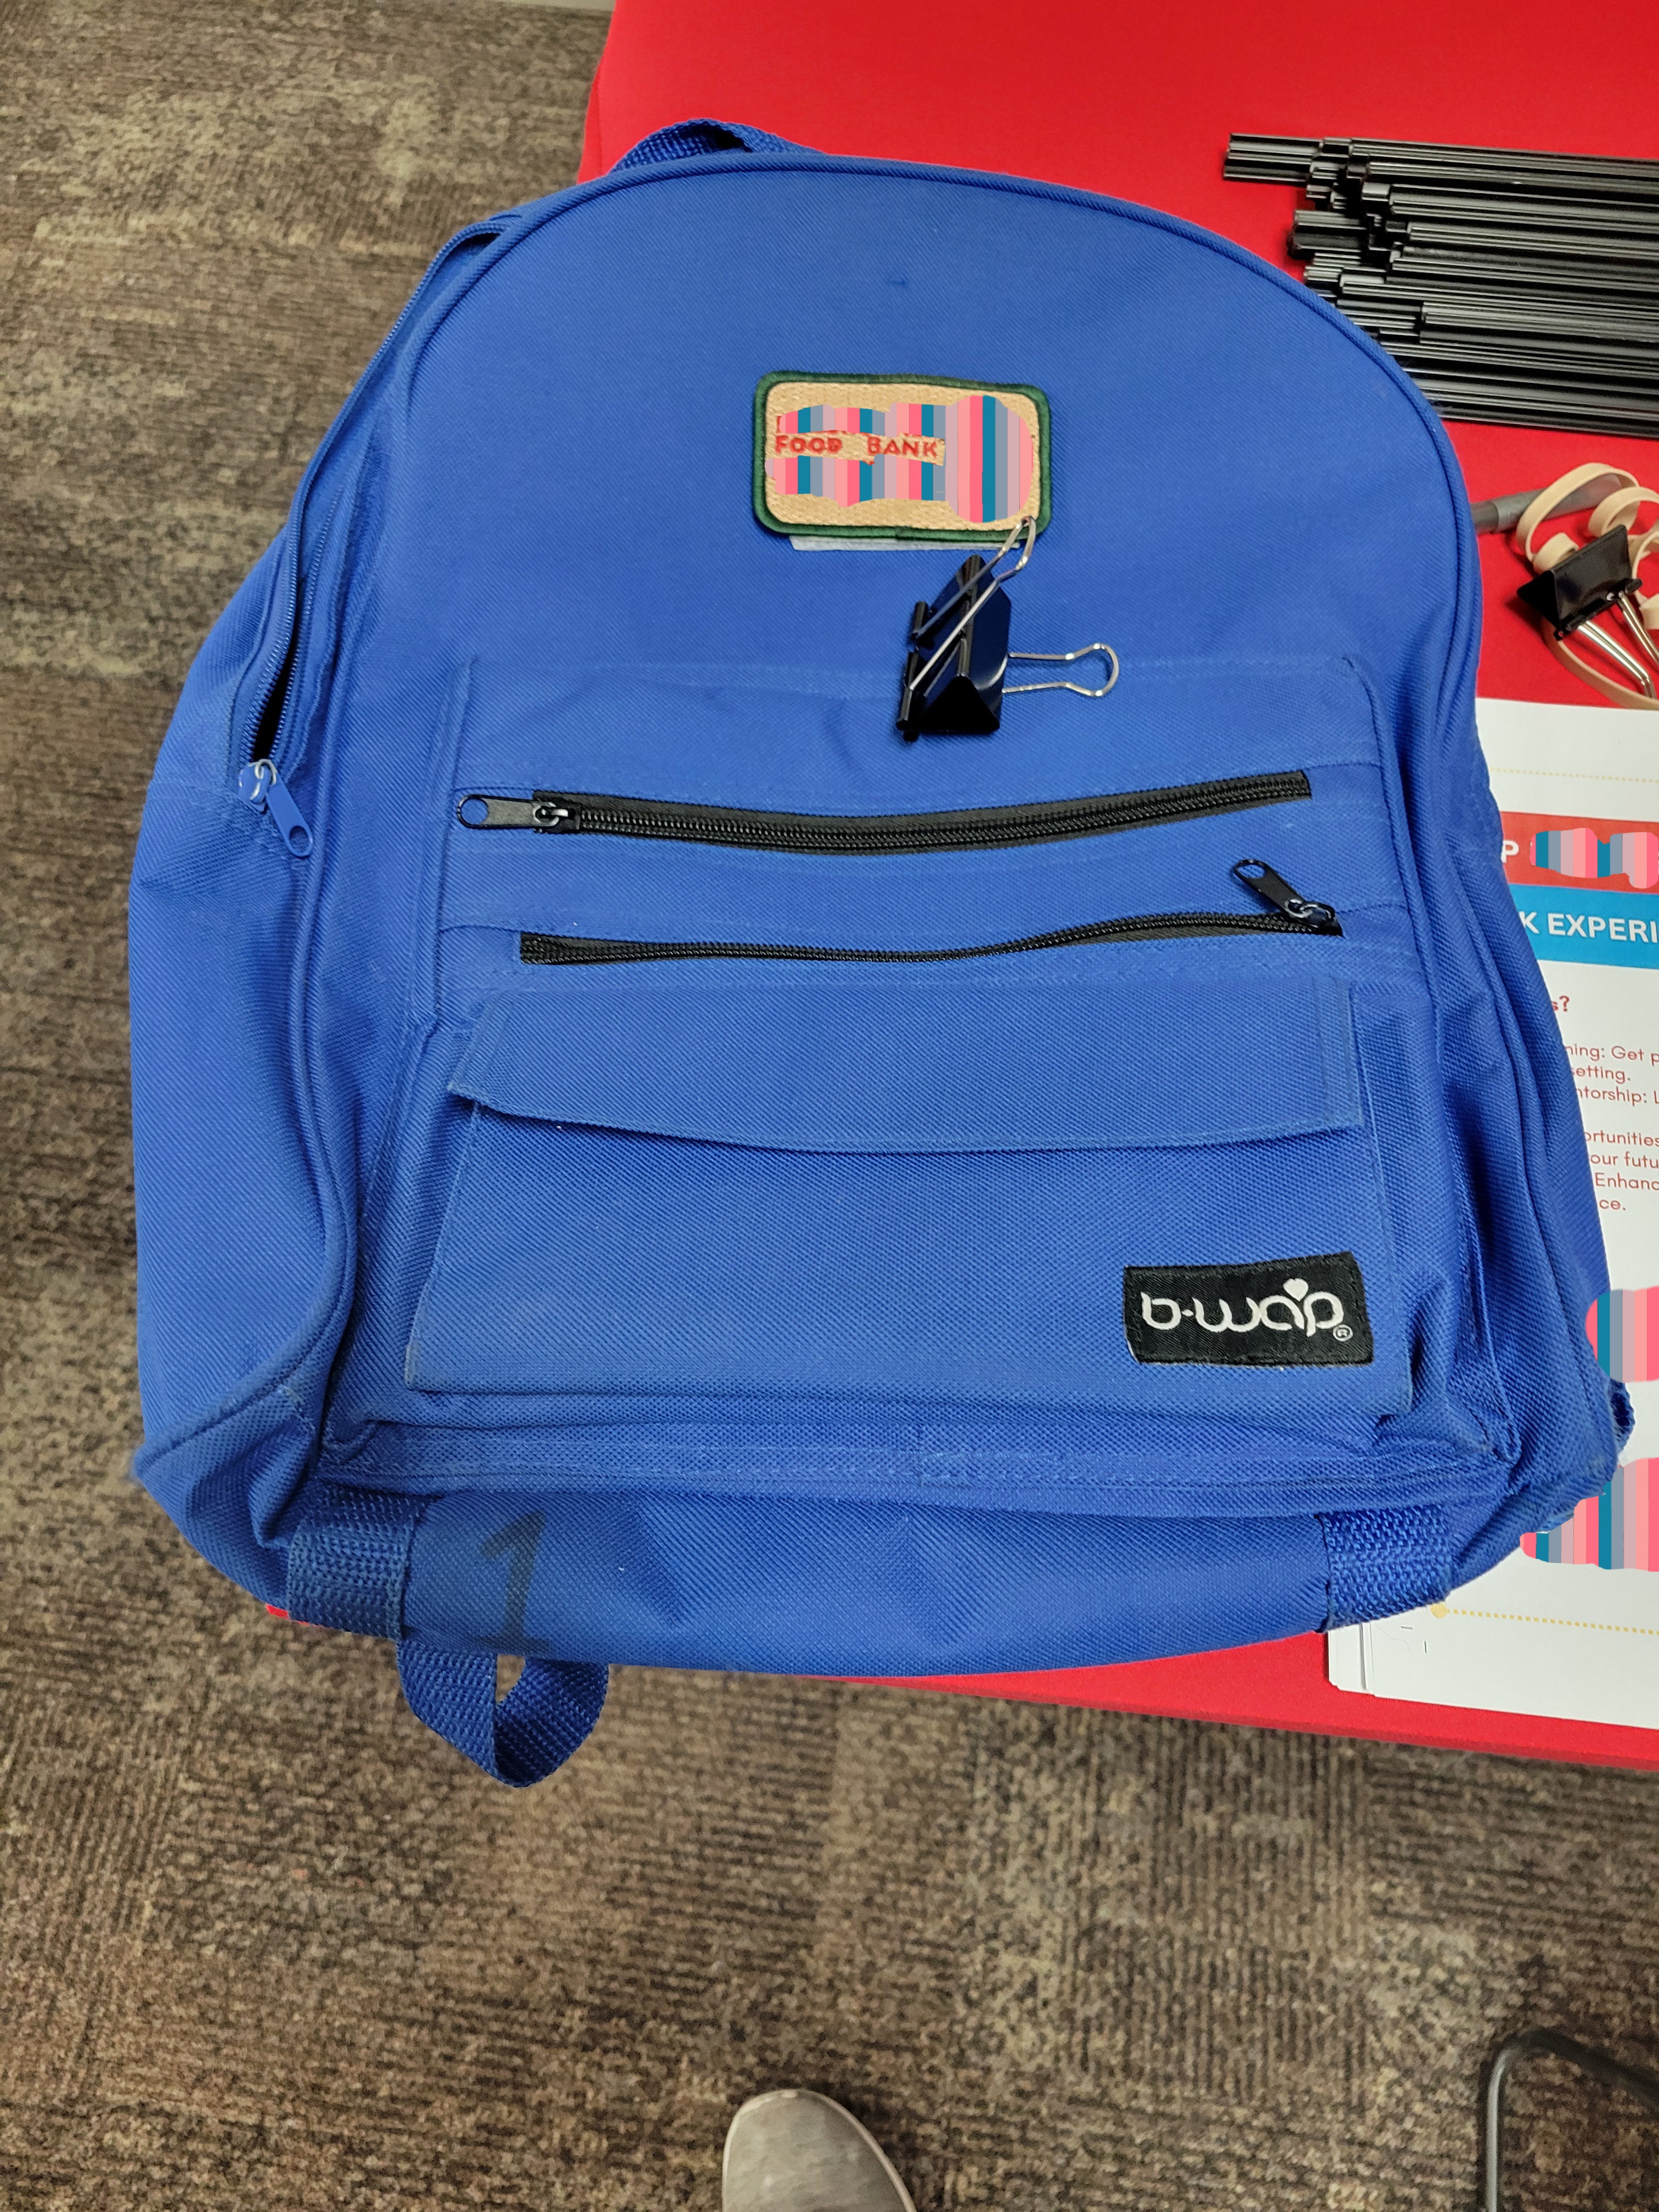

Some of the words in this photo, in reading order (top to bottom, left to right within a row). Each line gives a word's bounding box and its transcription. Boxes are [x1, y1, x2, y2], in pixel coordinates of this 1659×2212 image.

[775, 435, 843, 455] FOOD
[867, 435, 938, 457] BANK
[1519, 911, 1540, 934] K
[1547, 912, 1658, 944] EXPERI
[1611, 1045, 1644, 1060] Get
[1590, 1154, 1618, 1165] our
[1624, 1151, 1659, 1169] futu
[1595, 1172, 1659, 1190] Enhanc
[1599, 1199, 1626, 1211] ce.
